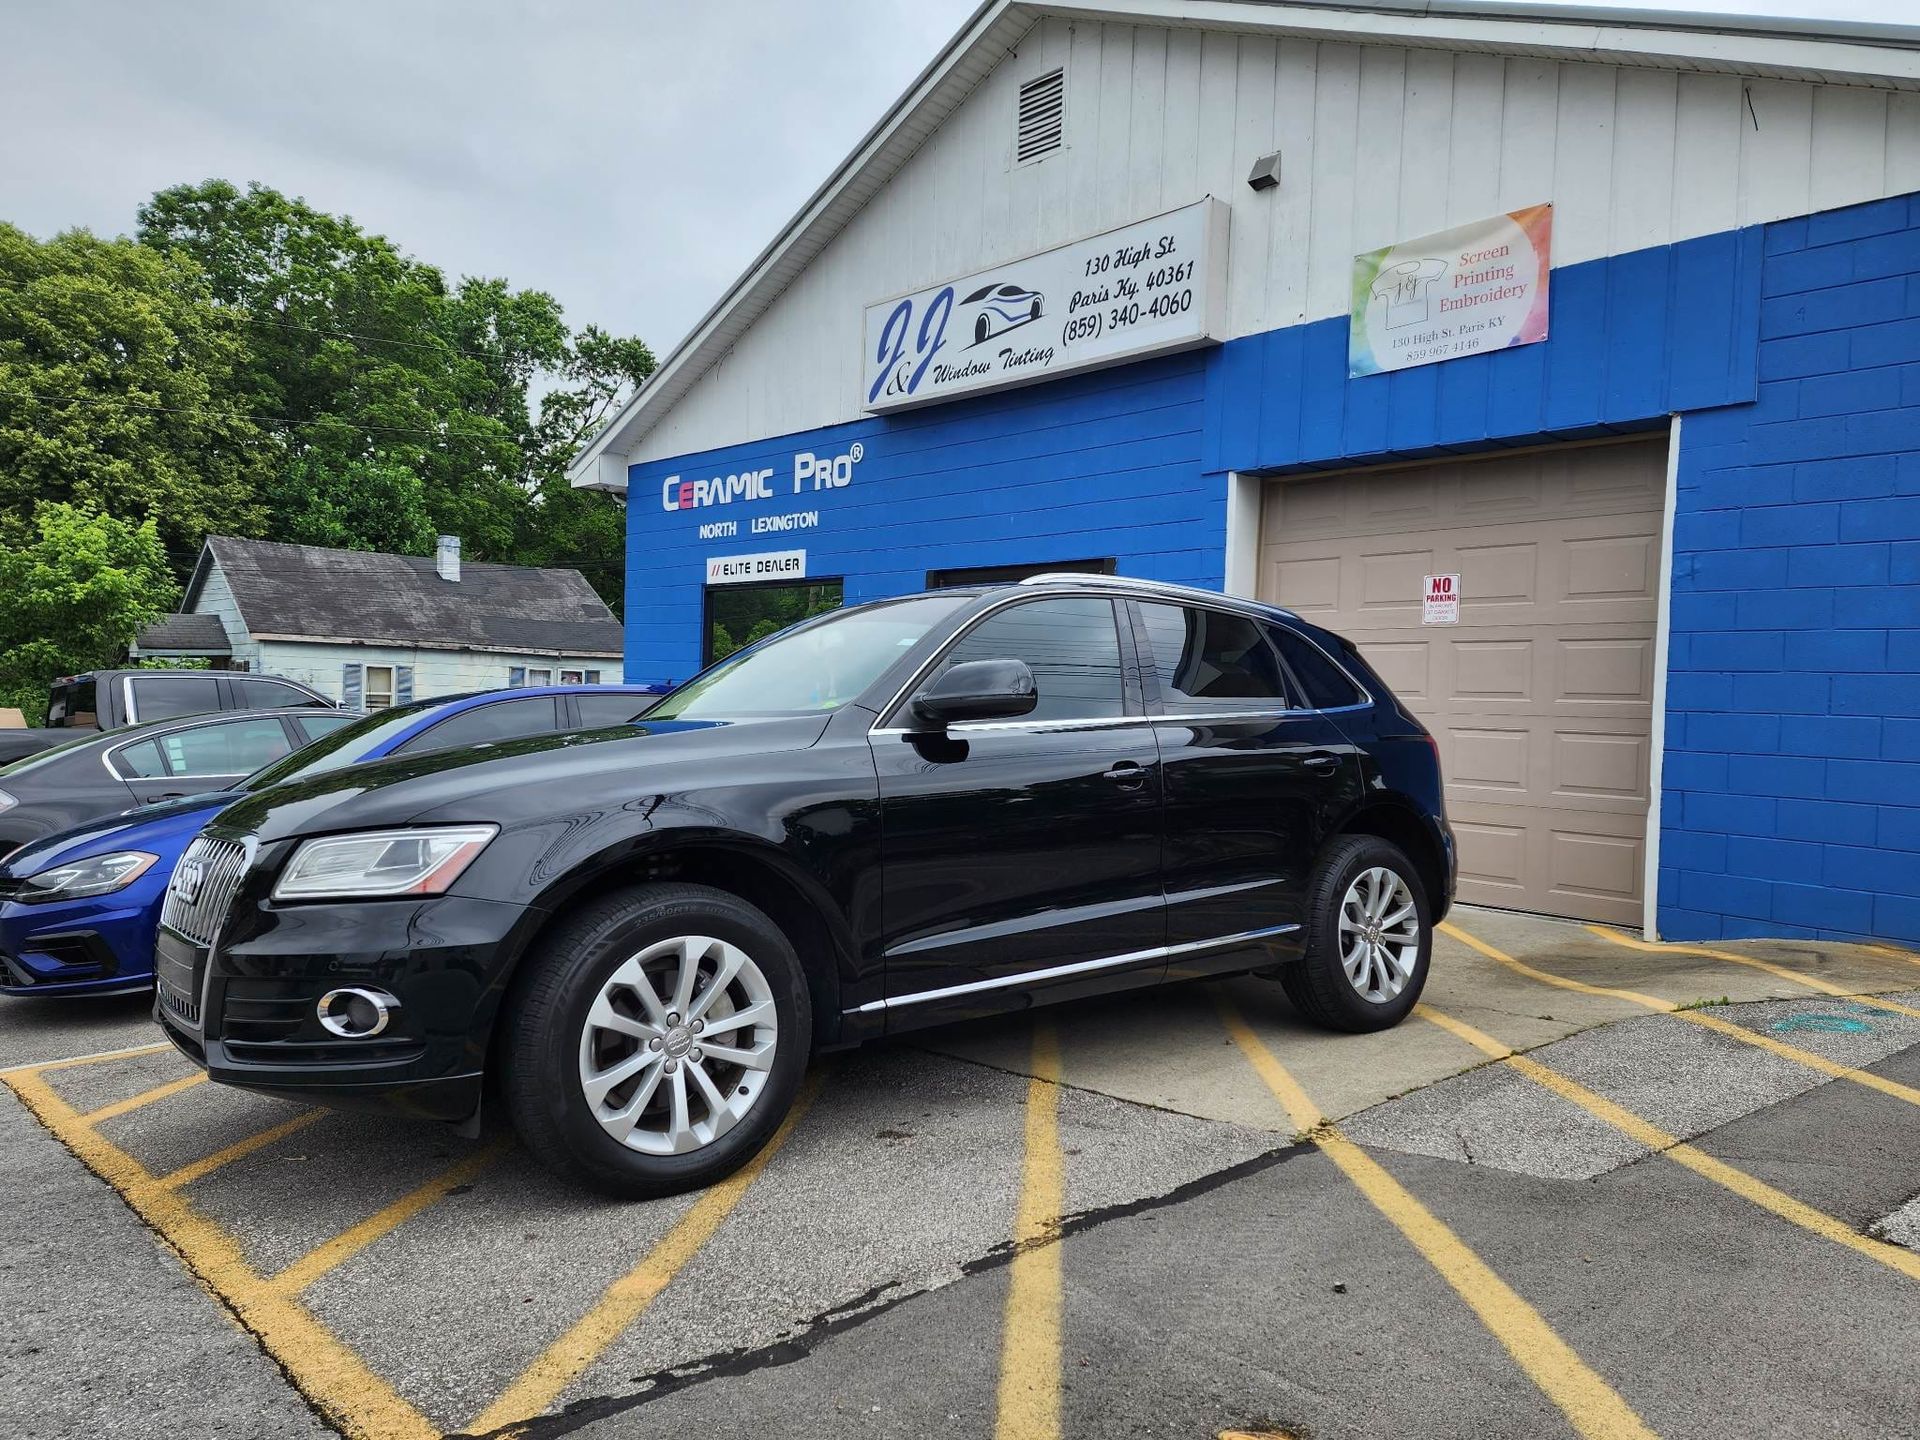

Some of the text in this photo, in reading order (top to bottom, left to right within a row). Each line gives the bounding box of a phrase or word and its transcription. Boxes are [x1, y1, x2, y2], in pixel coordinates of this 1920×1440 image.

[1085, 235, 1177, 277] 130 High St.
[1459, 244, 1510, 267] Screen
[1069, 260, 1194, 313] Paris Ky. 40361
[1454, 264, 1515, 289] Printing
[1439, 283, 1529, 313] Embroidery
[1062, 289, 1193, 347] (859) 340-4060
[1391, 315, 1506, 349] 130 High St. Paris KY
[1406, 338, 1480, 362] 859 967 4146
[933, 345, 1055, 385] Window Tinting
[662, 468, 773, 512] CERAMIC
[699, 511, 818, 540] NORTH LEXINGTON
[723, 558, 800, 576] ELITE DEALER
[1426, 594, 1457, 602] PARKING
[1432, 577, 1452, 594] NO
